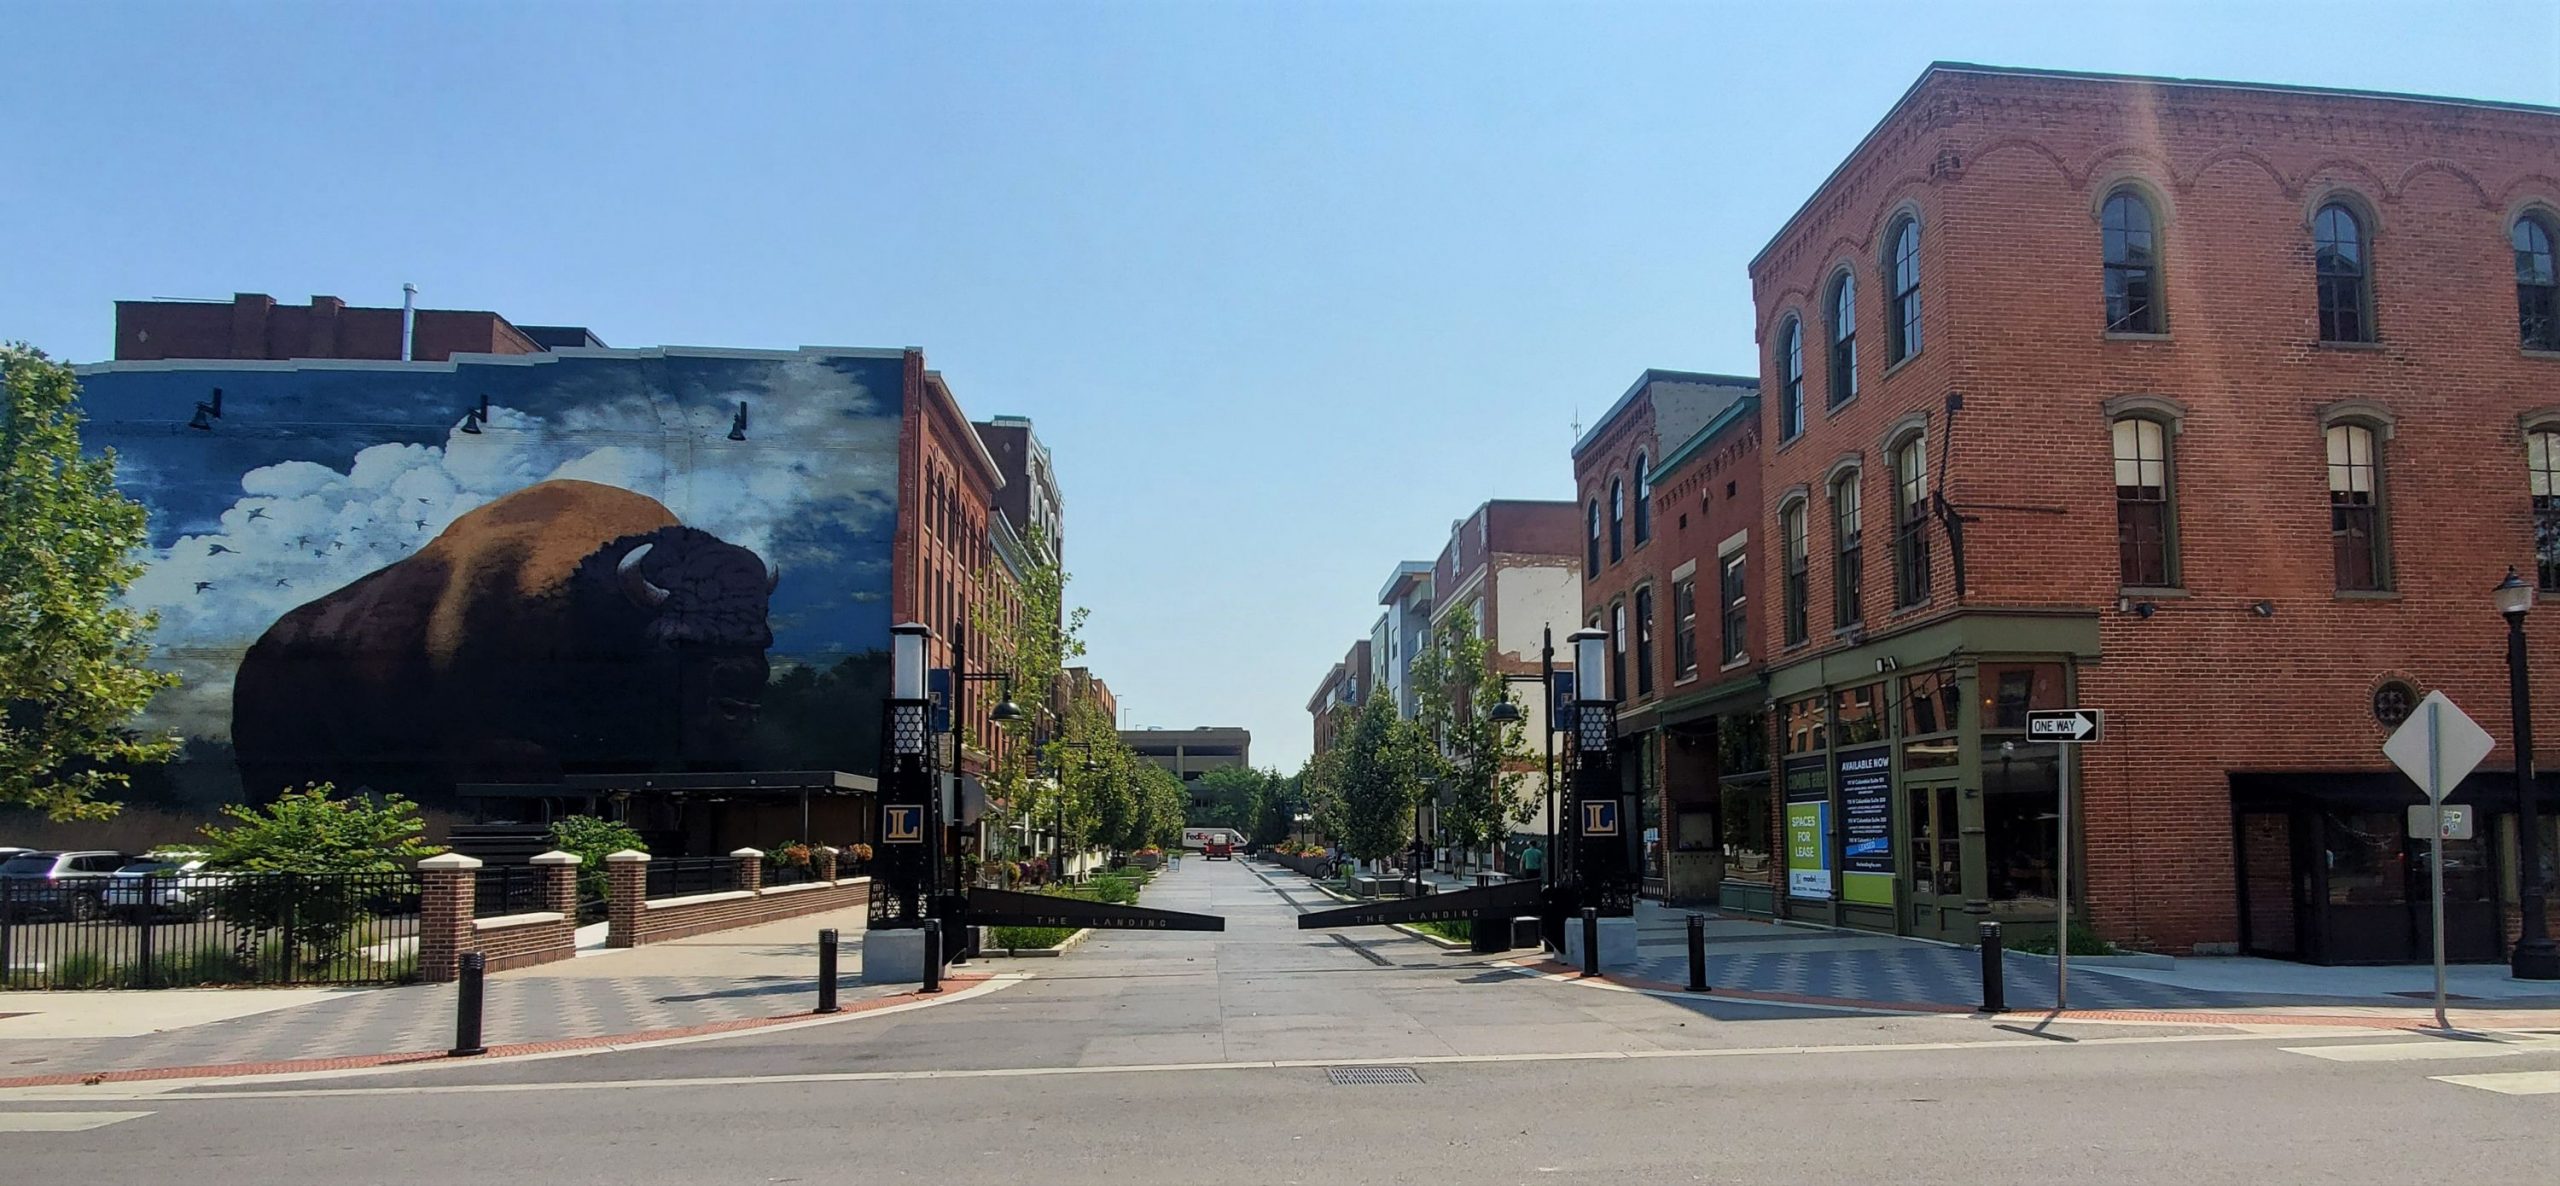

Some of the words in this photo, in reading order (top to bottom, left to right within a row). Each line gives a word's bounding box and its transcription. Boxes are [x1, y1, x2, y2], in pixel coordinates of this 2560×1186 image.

[2034, 720, 2053, 732] ONE
[2056, 720, 2075, 732] WAY
[1842, 760, 1873, 771] AVAILABLE
[1873, 757, 1890, 768] NOW
[1791, 816, 1816, 827] SPACES
[1186, 832, 1209, 840] FedEx
[1797, 831, 1811, 842] FOR
[1795, 846, 1814, 857] LEASE
[1036, 916, 1067, 925] THE
[1092, 918, 1167, 927] LANDING
[1356, 915, 1385, 923] THE
[1408, 909, 1479, 920] LANDING
